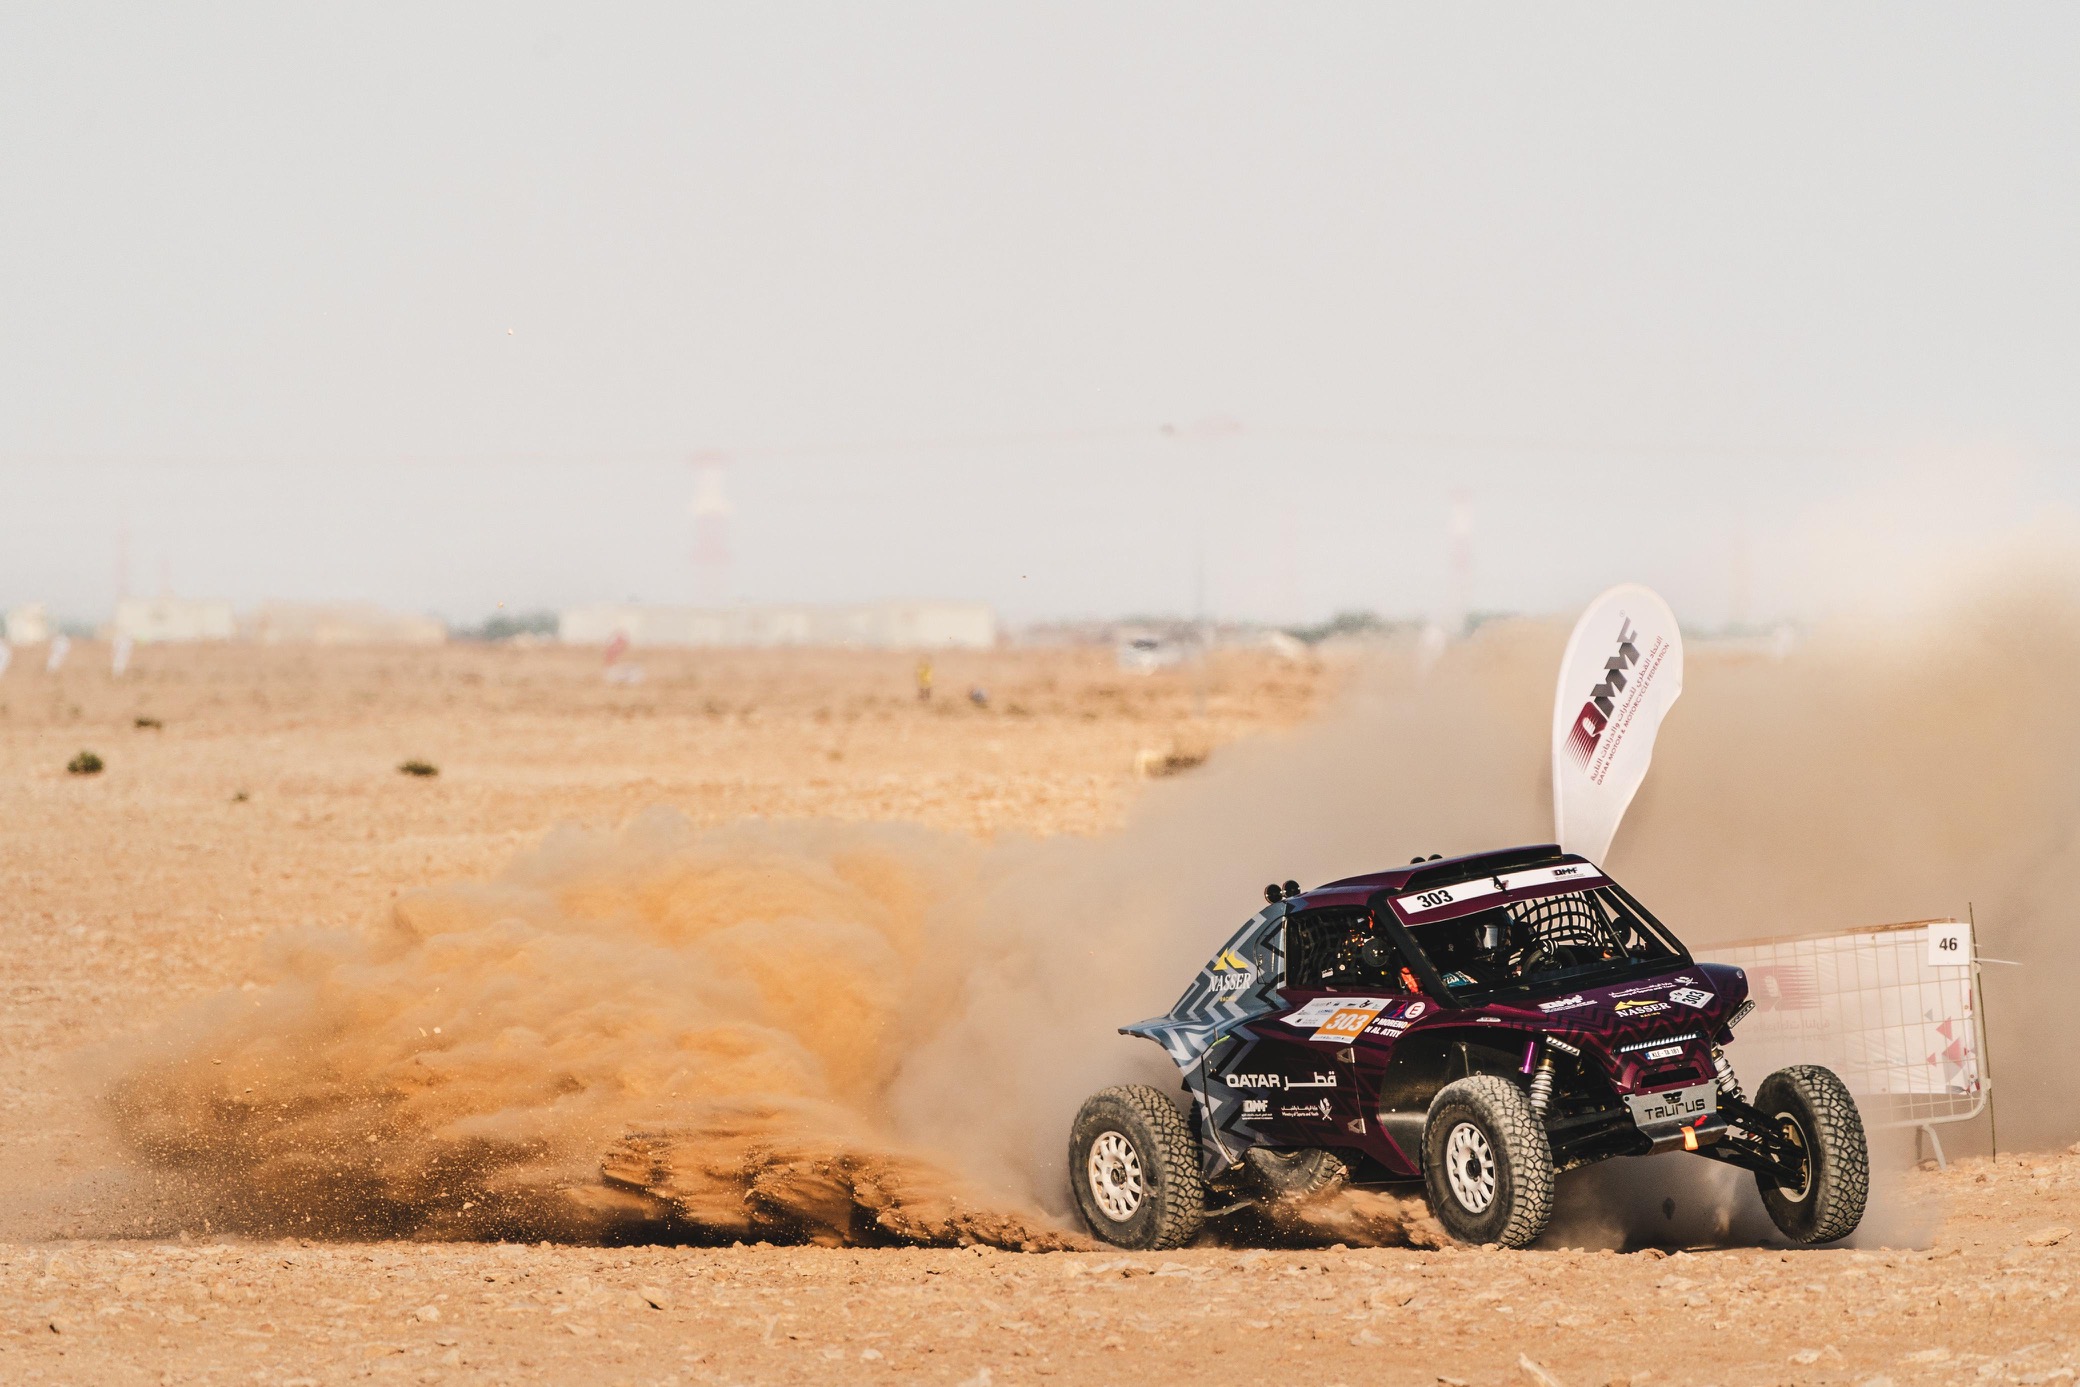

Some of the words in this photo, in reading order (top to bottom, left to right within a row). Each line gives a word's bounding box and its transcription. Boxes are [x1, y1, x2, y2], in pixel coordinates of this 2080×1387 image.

[1563, 617, 1640, 774] QMMF
[1596, 760, 1610, 786] QATAR
[1607, 733, 1622, 760] MOTOR
[1623, 680, 1649, 726] MOTORCYCLE
[1646, 642, 1670, 682] FEDERATION
[1417, 890, 1454, 908] 303
[1939, 937, 1958, 951] 46
[1208, 972, 1251, 992] NASSER
[1682, 991, 1705, 1005] 303
[1409, 1005, 1421, 1016] E
[1616, 1002, 1672, 1018] NASSER
[1326, 1013, 1369, 1031] 303
[1372, 1017, 1380, 1025] P
[1378, 1018, 1408, 1029] MORENO
[1226, 1073, 1281, 1088] QATAR
[1283, 1070, 1337, 1091] قطر
